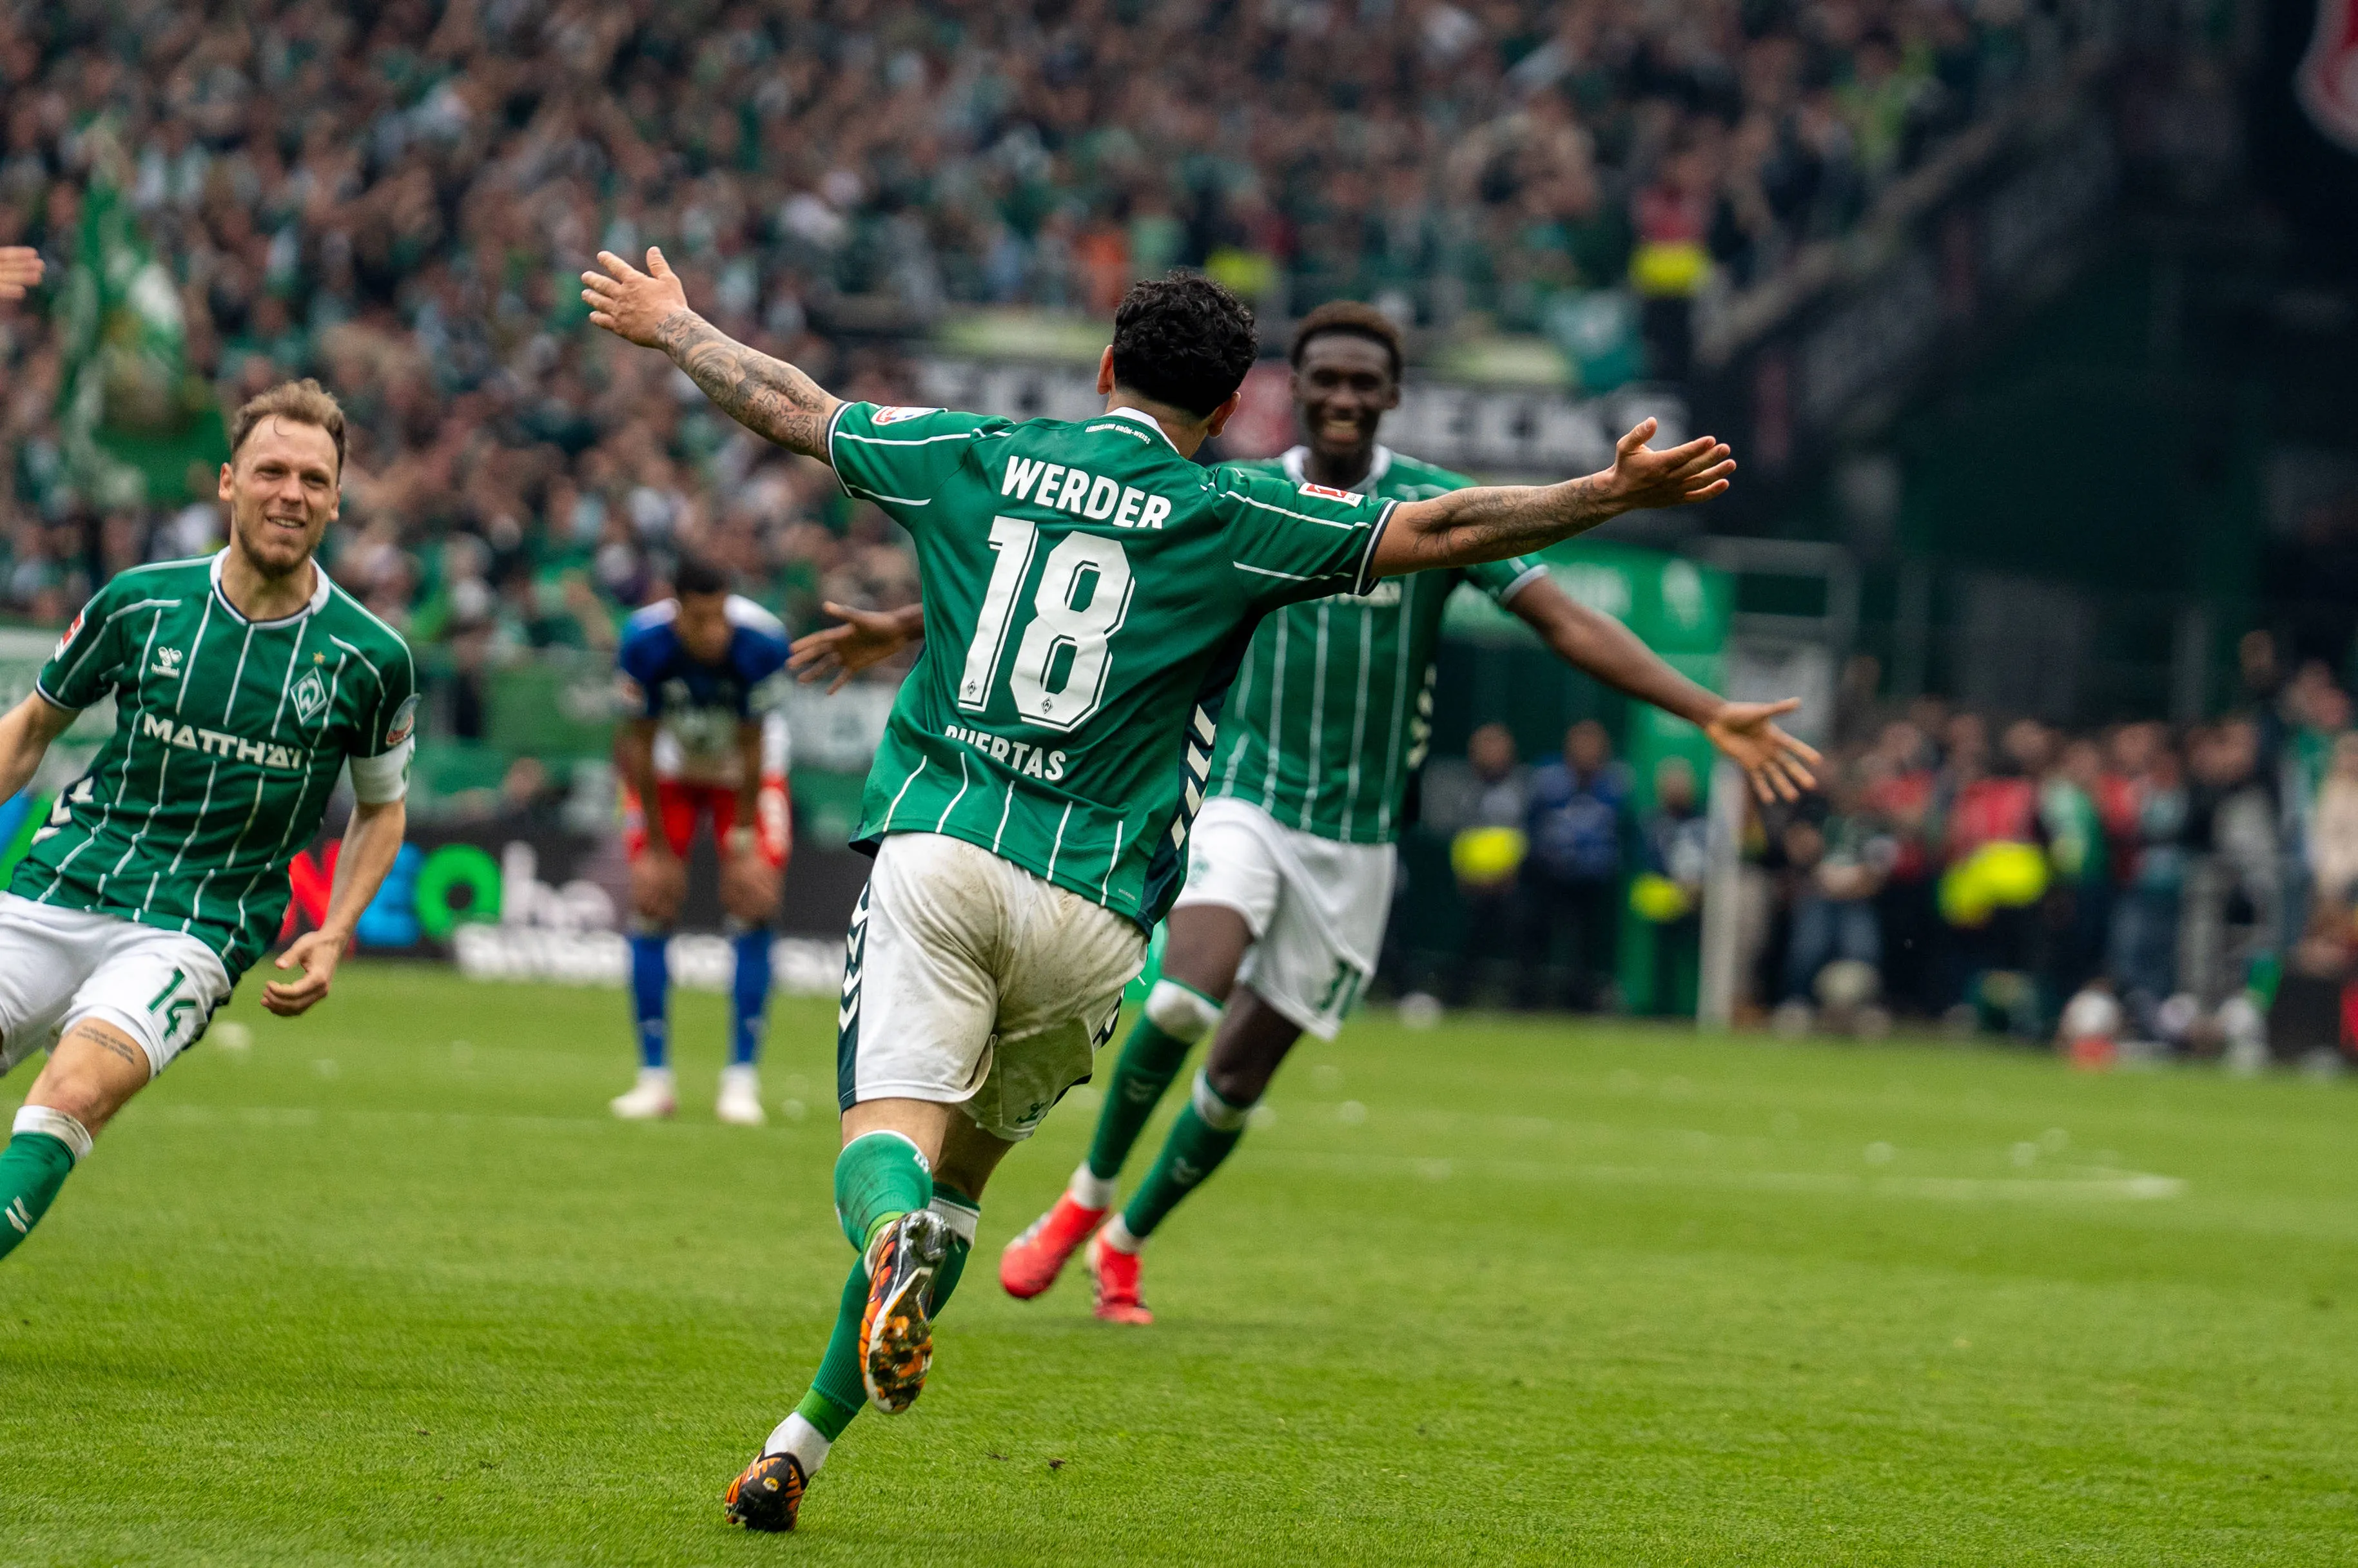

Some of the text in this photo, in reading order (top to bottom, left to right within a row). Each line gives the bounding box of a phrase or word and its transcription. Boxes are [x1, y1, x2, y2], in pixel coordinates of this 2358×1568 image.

[1115, 425, 1151, 444] GRÜN-WEISS
[1000, 455, 1172, 529] WERDER
[957, 515, 1136, 733] 18
[145, 965, 197, 1042] 14
